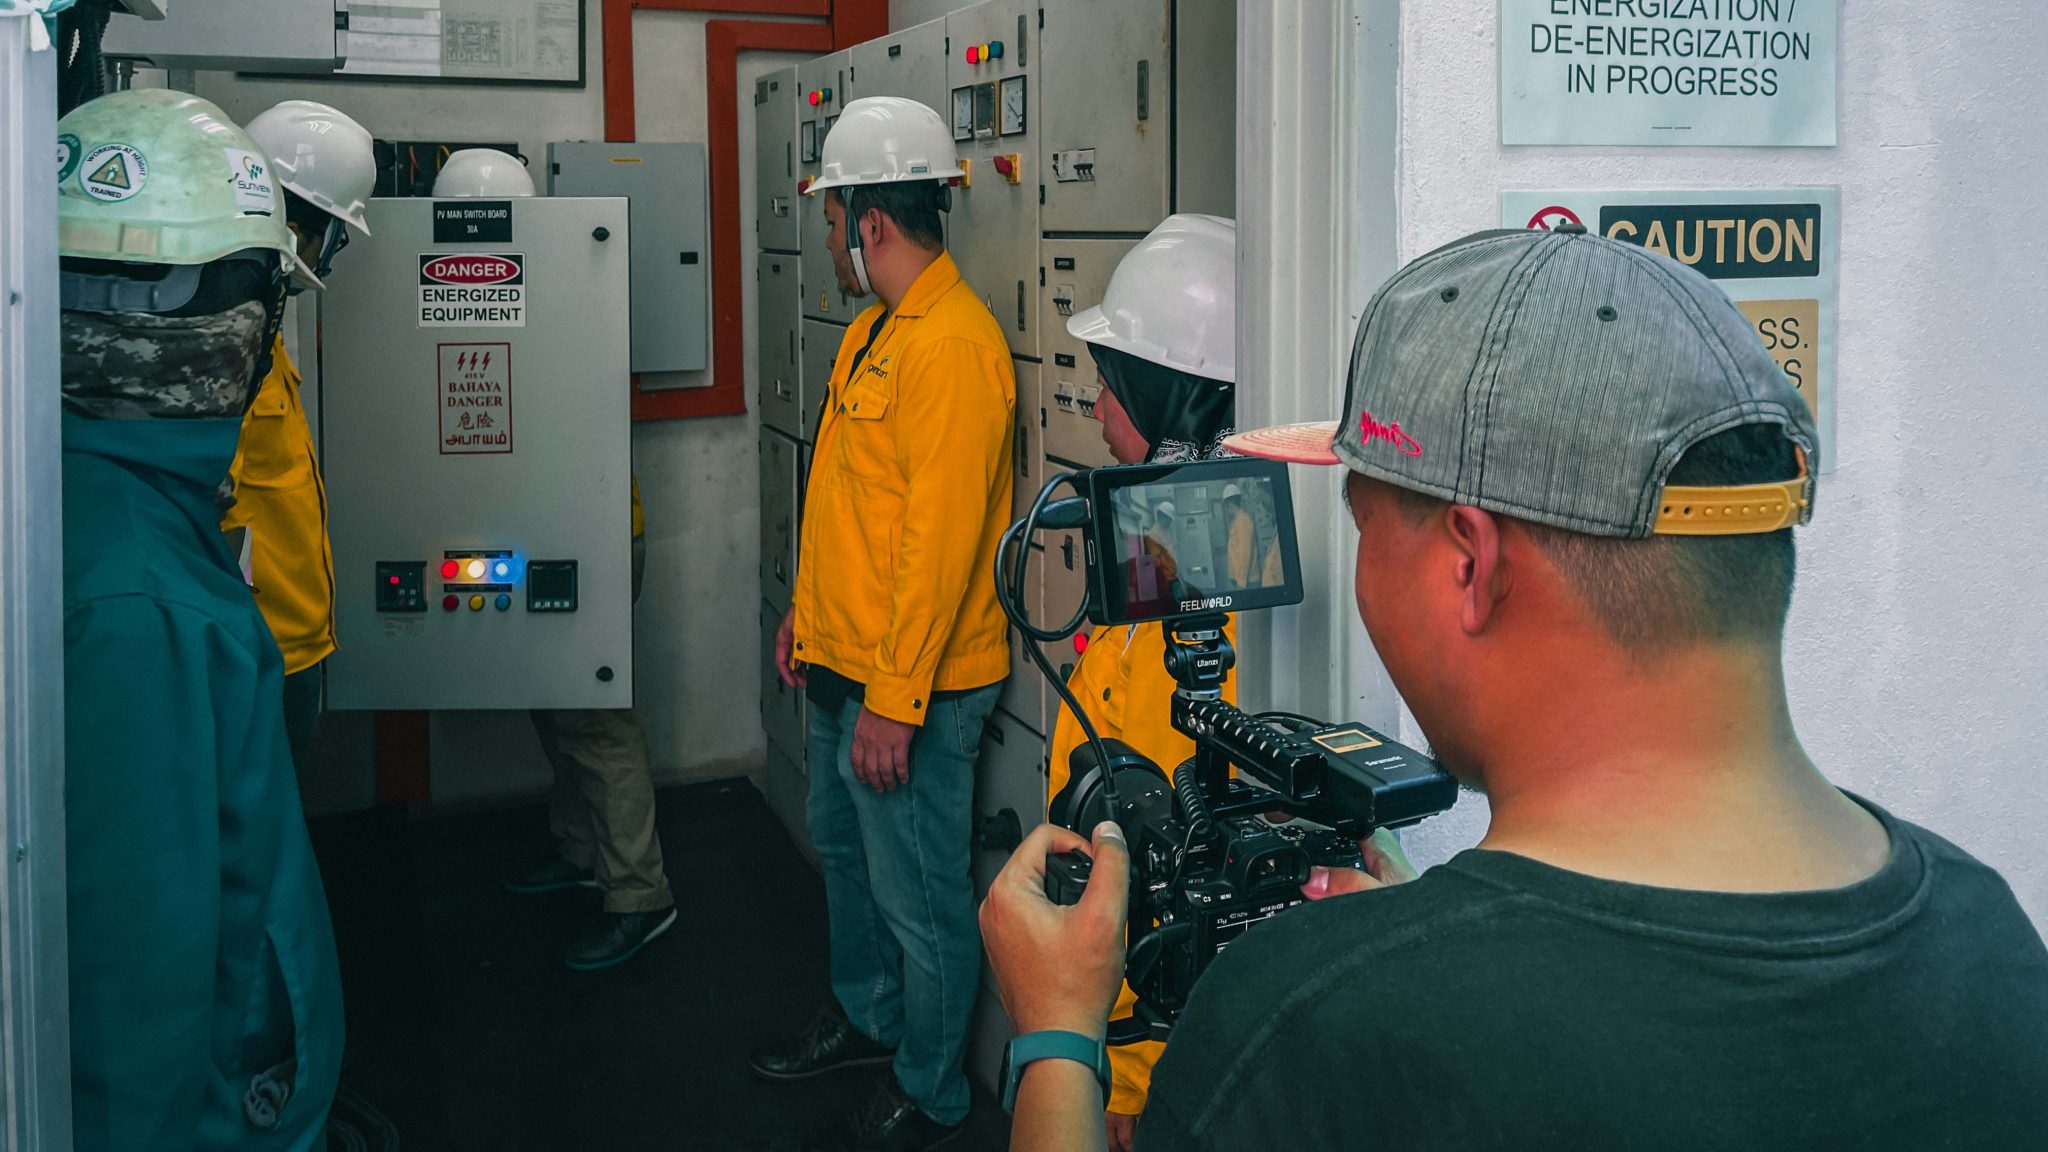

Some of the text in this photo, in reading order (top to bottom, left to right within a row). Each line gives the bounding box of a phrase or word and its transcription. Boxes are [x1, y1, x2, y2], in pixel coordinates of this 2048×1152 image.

[1531, 24, 1810, 60] DE-ENERGIZATION
[1567, 64, 1778, 96] IN PROGRESS
[87, 145, 122, 162] WORKING
[131, 152, 146, 176] HEIGHT
[90, 186, 122, 198] TRAINED
[437, 209, 508, 219] PV MAIN SWITCH BOARD
[467, 225, 479, 234] 30A
[434, 263, 507, 277] DANGER
[423, 289, 520, 302] ENERGIZED
[422, 308, 521, 322] EQUIPMENT
[448, 382, 502, 393] BAHAYA
[447, 396, 503, 407] DANGER
[457, 411, 494, 430] 危险
[1180, 596, 1232, 612] FEELWORLD
[1197, 659, 1219, 668] Ulanzi
